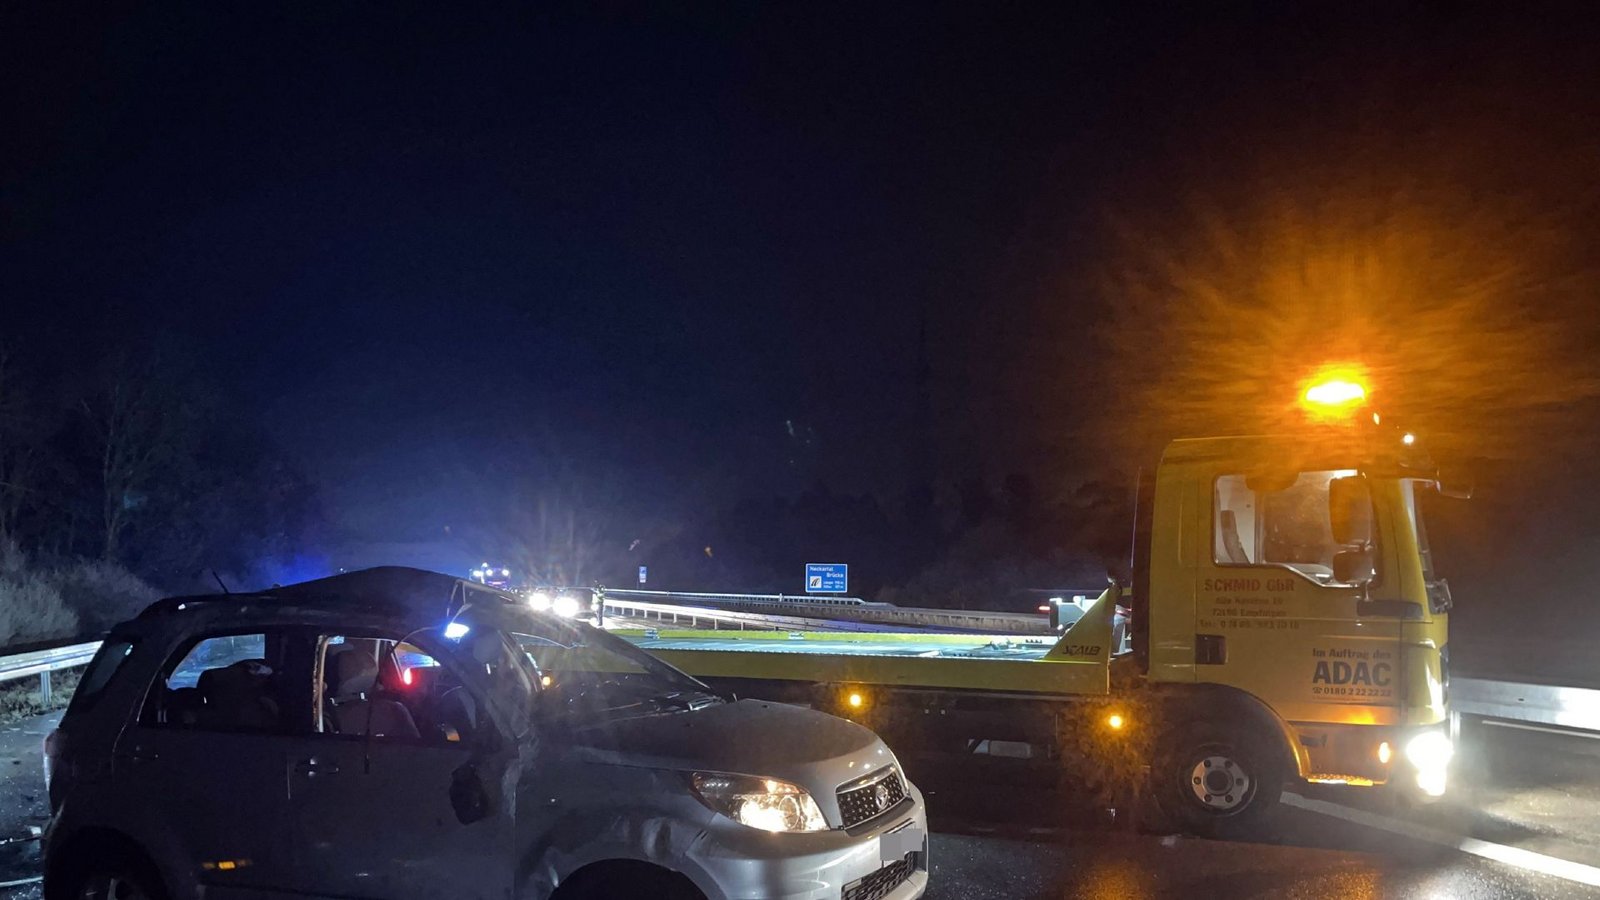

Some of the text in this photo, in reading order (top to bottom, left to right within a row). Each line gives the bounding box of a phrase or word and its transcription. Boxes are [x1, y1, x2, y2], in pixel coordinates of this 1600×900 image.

[1204, 579, 1295, 592] SCHMID GbR
[1313, 647, 1391, 659] Im Auftrag des
[1312, 661, 1392, 687] ADAC
[1324, 687, 1346, 695] 0180
